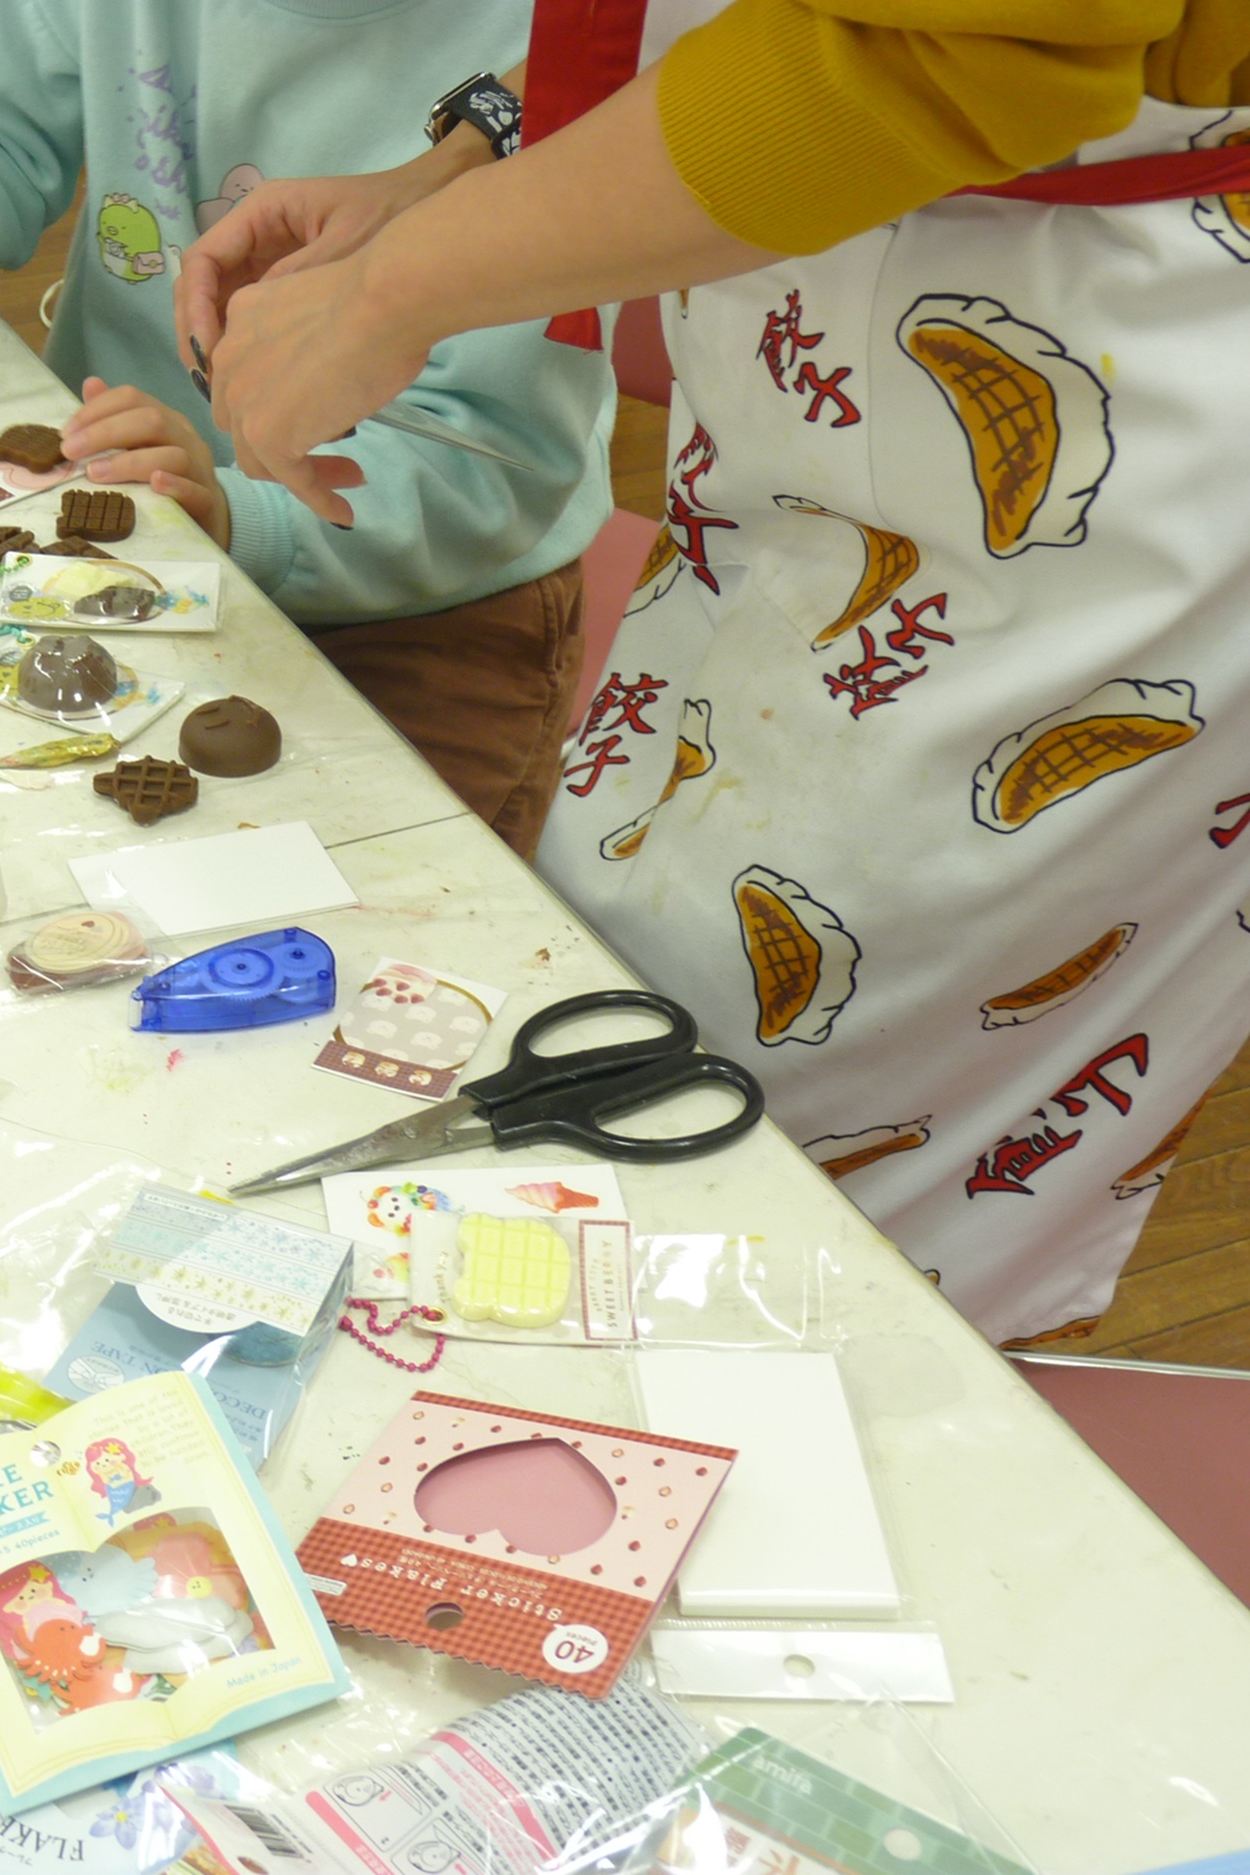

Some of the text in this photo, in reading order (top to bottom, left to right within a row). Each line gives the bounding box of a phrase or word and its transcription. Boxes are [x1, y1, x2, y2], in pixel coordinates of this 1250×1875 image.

[563, 671, 669, 797] 餃子
[90, 1340, 139, 1369] TAPE
[358, 1555, 448, 1592] Flakes
[458, 1582, 564, 1622] Sticker
[552, 1638, 597, 1667] 40
[750, 1750, 818, 1797] amifa
